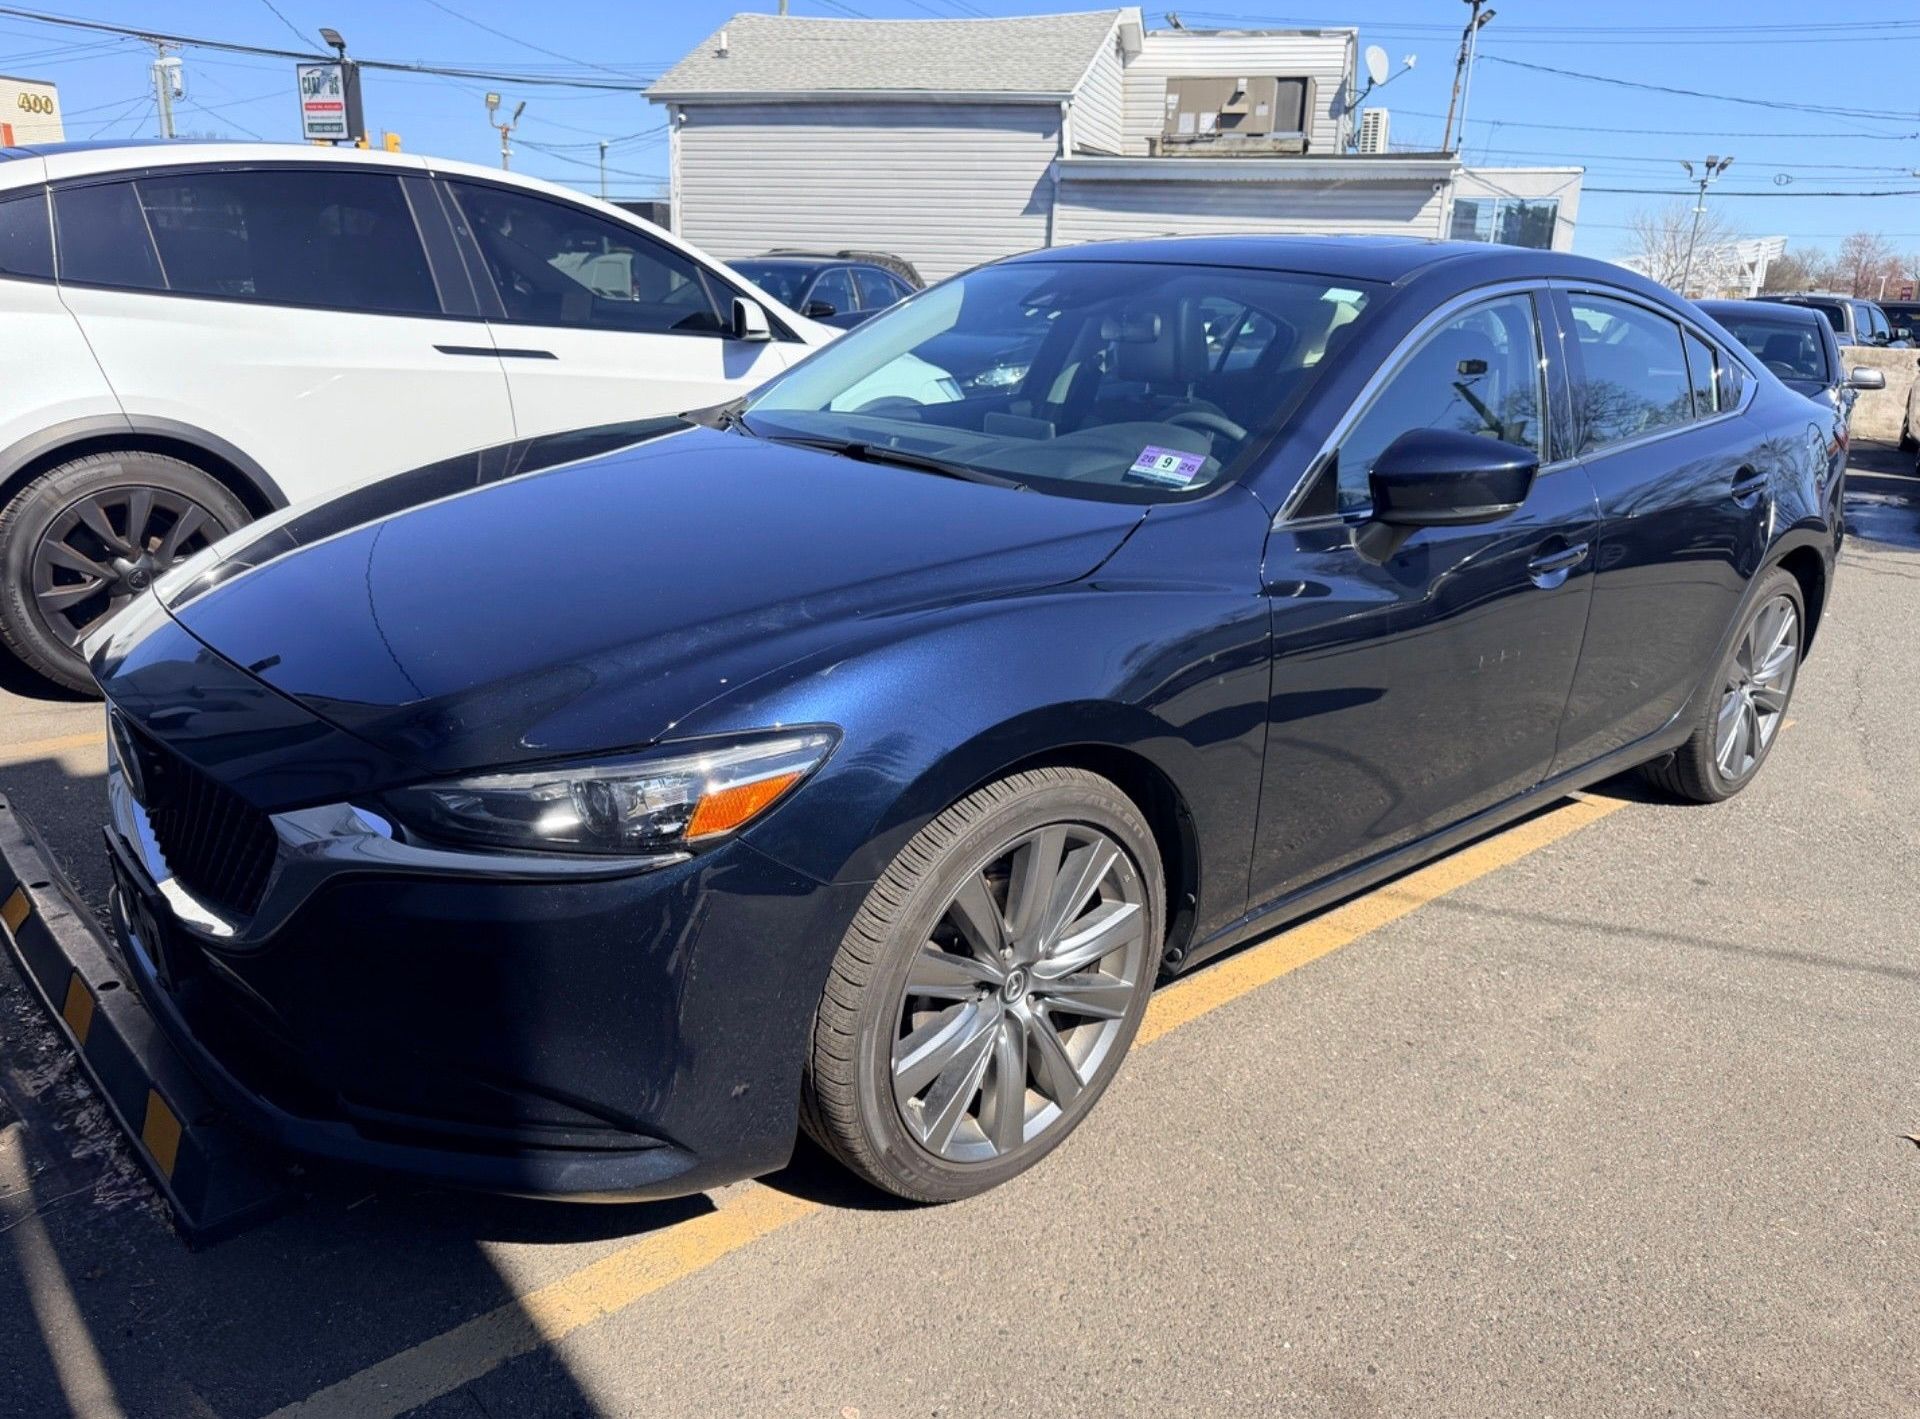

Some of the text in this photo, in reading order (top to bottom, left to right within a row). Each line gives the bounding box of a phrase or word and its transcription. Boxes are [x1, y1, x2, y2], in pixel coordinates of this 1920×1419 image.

[18, 92, 54, 115] 400
[1140, 454, 1155, 463] 20
[1162, 456, 1173, 468] 9
[1180, 462, 1196, 472] 26
